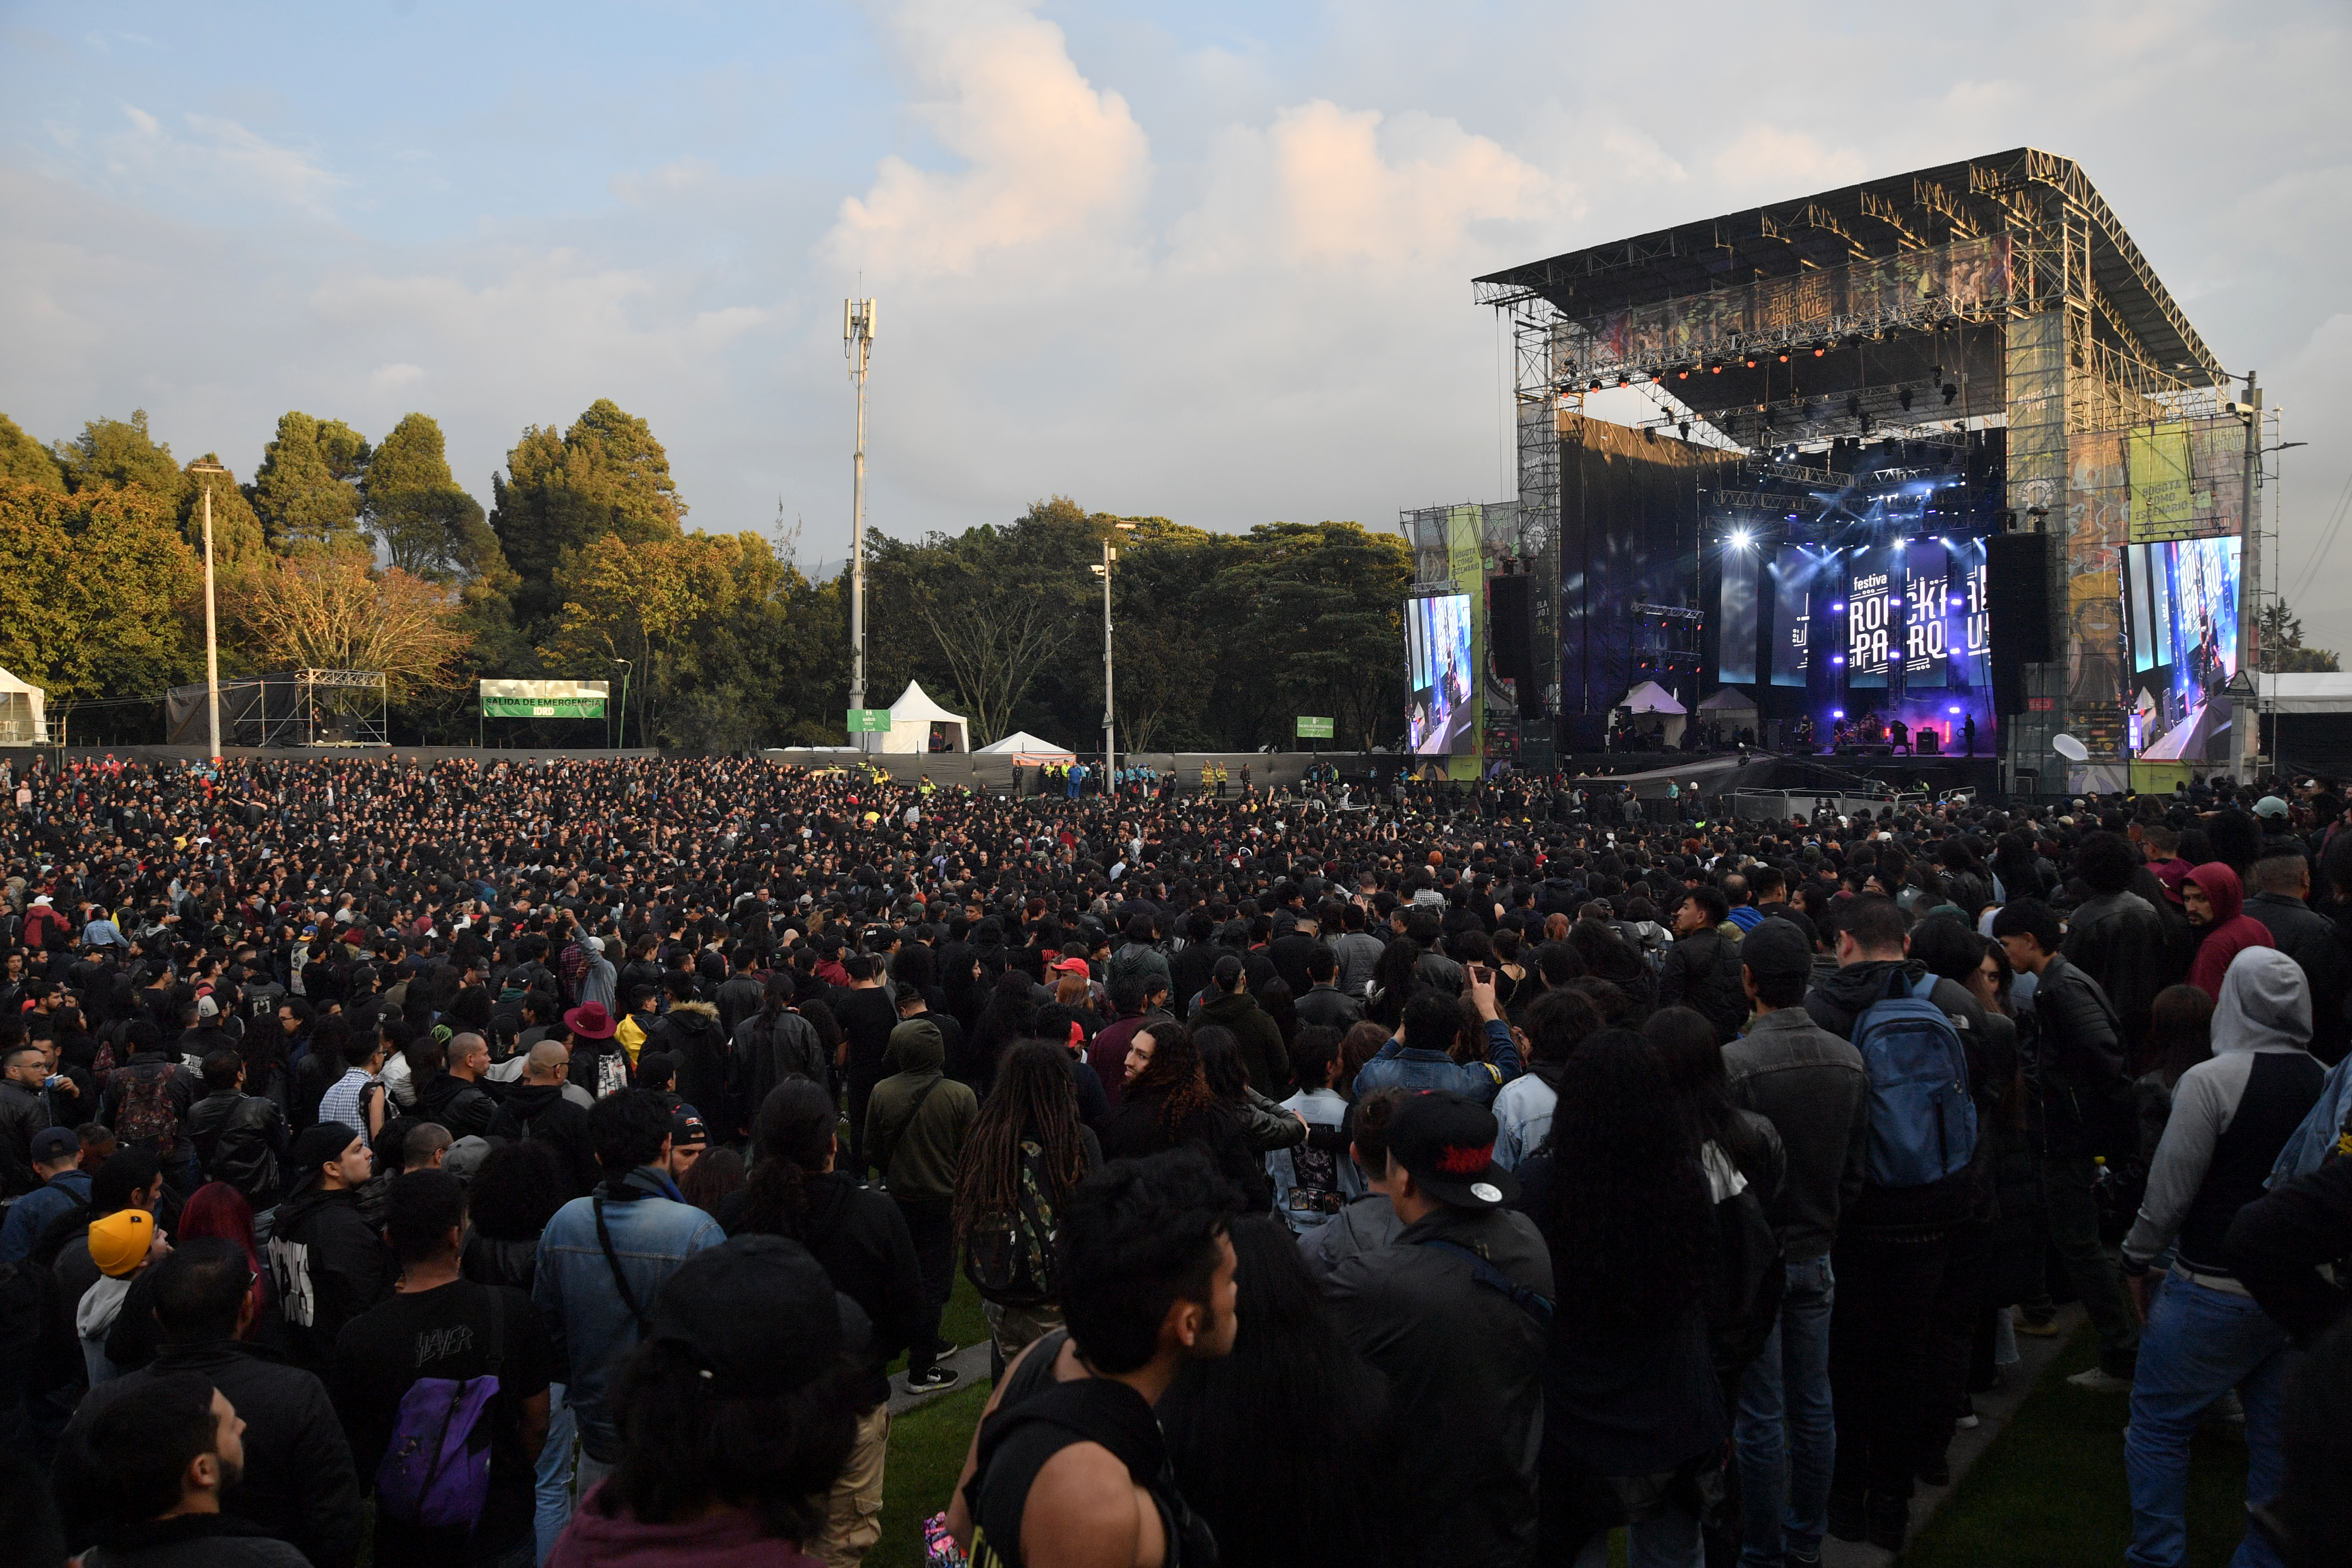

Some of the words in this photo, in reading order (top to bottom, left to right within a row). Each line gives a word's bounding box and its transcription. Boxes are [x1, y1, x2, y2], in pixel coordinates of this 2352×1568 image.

[1764, 285, 1803, 320] ROCK
[1771, 296, 1828, 326] PARQUE
[2136, 501, 2188, 520] ESCENARIO
[1457, 556, 1473, 567] COMO
[1451, 563, 1480, 576] ESCENARIO
[537, 699, 601, 707] EMERGENCIA
[533, 707, 555, 716] IDRD
